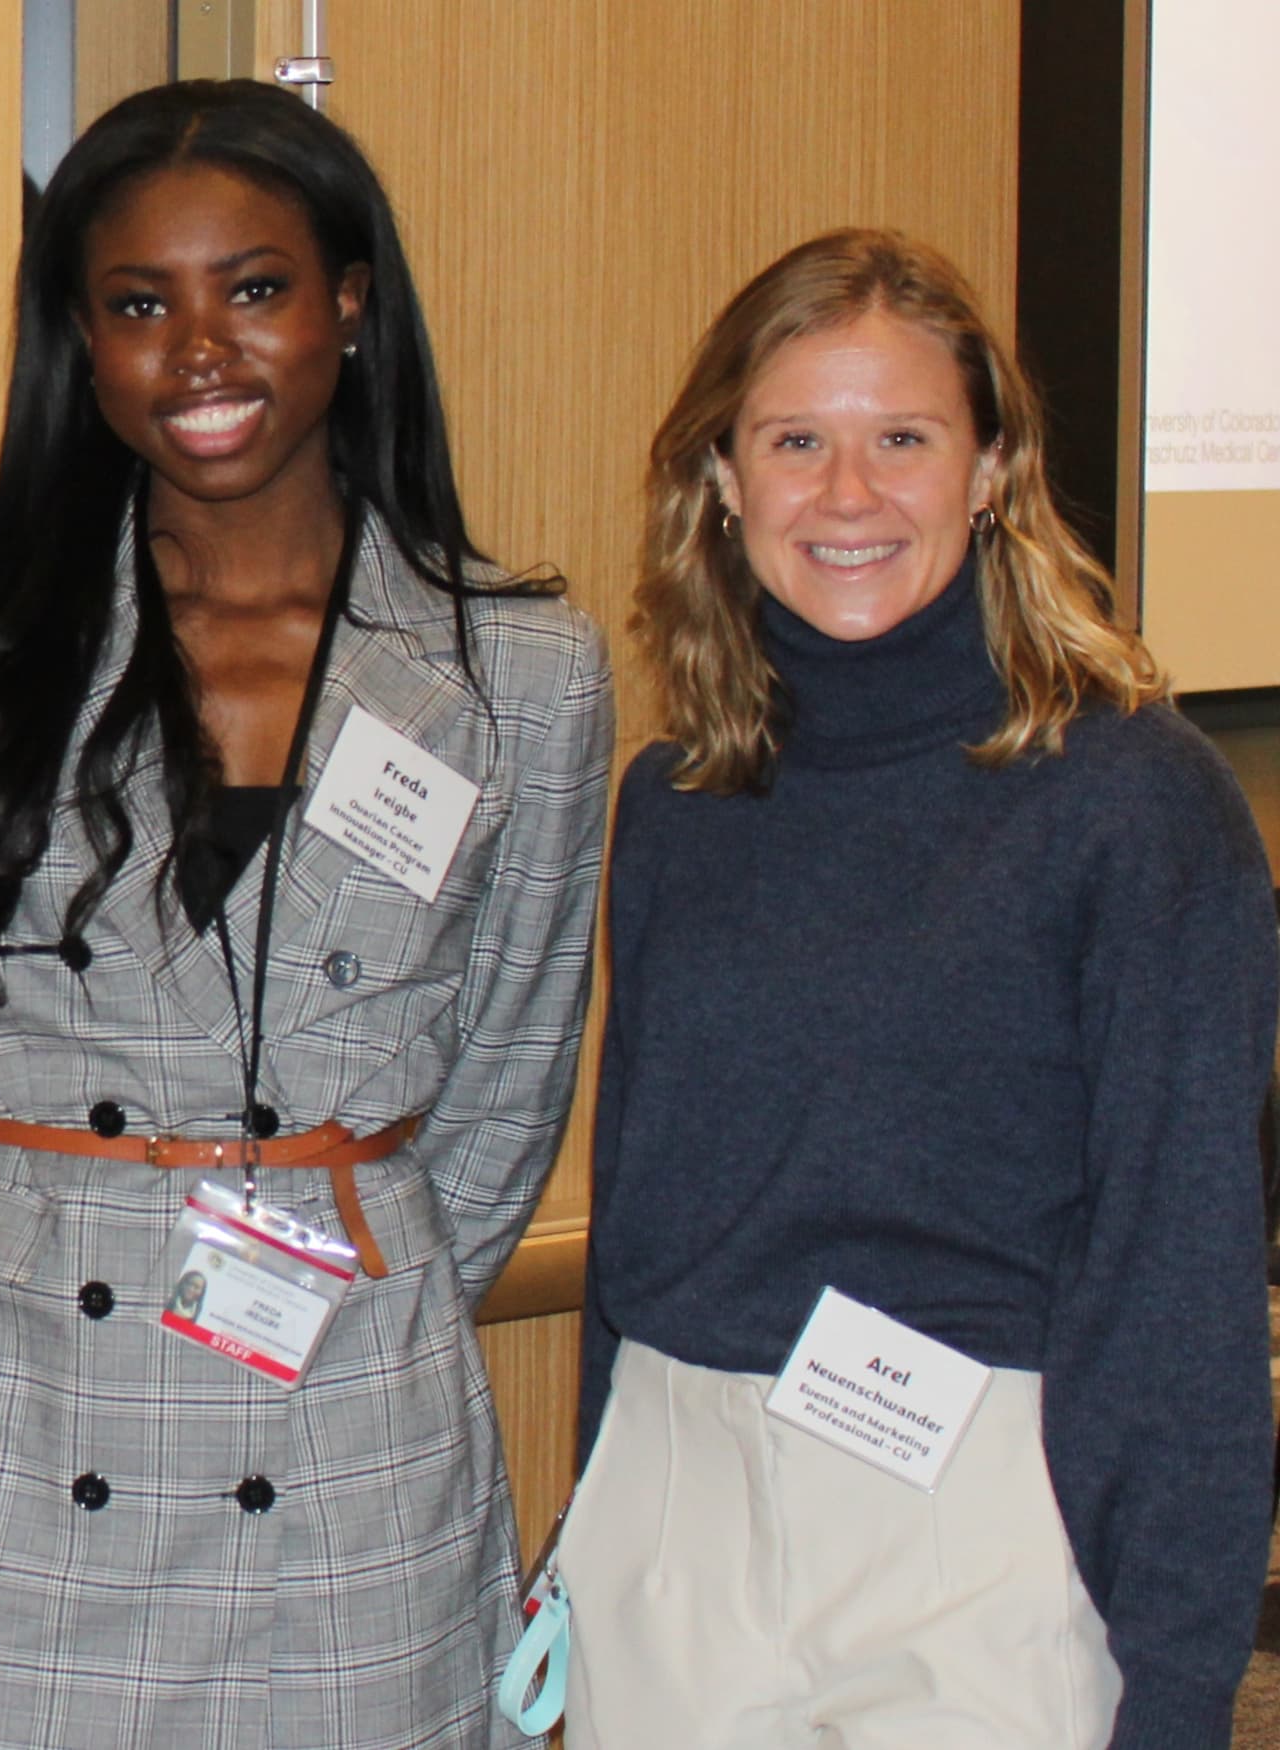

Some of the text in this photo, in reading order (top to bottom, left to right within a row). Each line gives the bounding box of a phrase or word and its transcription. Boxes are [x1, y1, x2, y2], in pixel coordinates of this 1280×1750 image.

[383, 761, 428, 800] Freda
[329, 803, 431, 876] Innovations Program
[343, 828, 386, 864] Manager
[393, 860, 408, 876] CU
[349, 799, 424, 853] Ovarian Cancer
[209, 1334, 253, 1361] STAFF
[866, 1355, 912, 1388] Arel
[798, 1382, 930, 1457] Events and Marketing
[807, 1358, 944, 1435] Neuenschwander
[804, 1401, 885, 1449] Professional
[892, 1446, 912, 1462] CU
